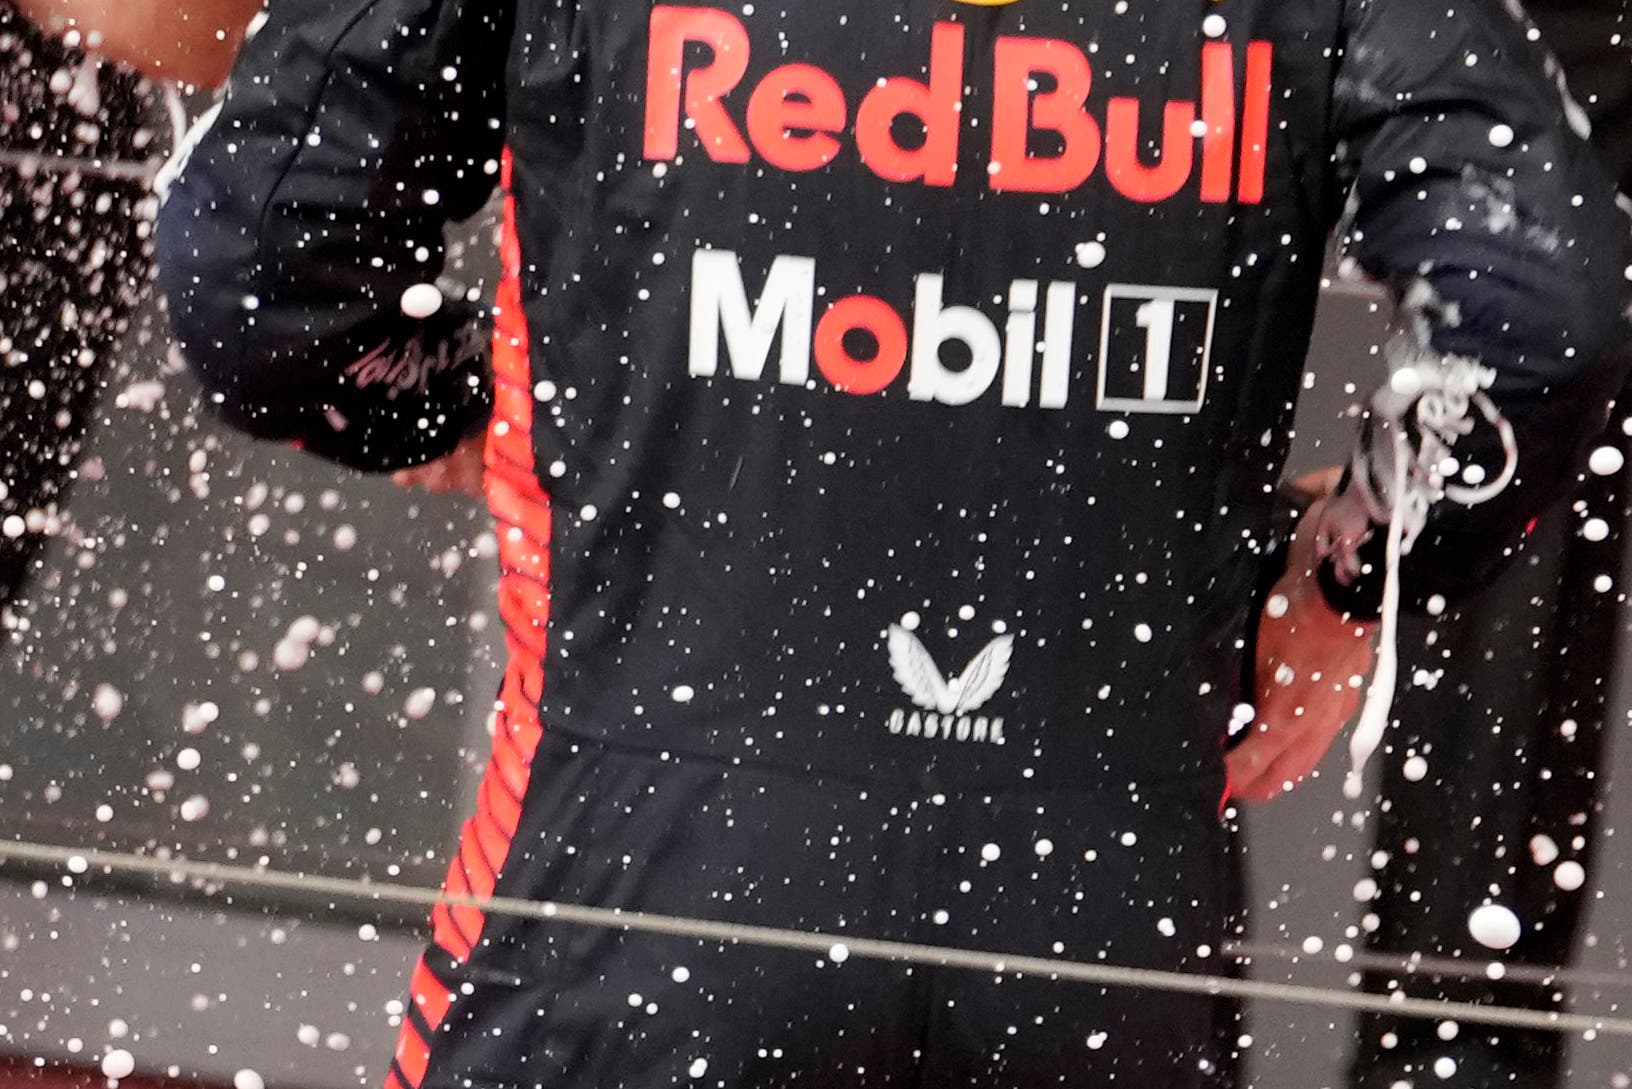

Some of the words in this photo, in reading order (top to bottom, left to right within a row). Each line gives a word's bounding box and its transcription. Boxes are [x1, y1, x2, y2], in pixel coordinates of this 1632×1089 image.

[644, 6, 964, 187] Red
[989, 36, 1272, 204] Bull
[689, 248, 1076, 409] Mobil
